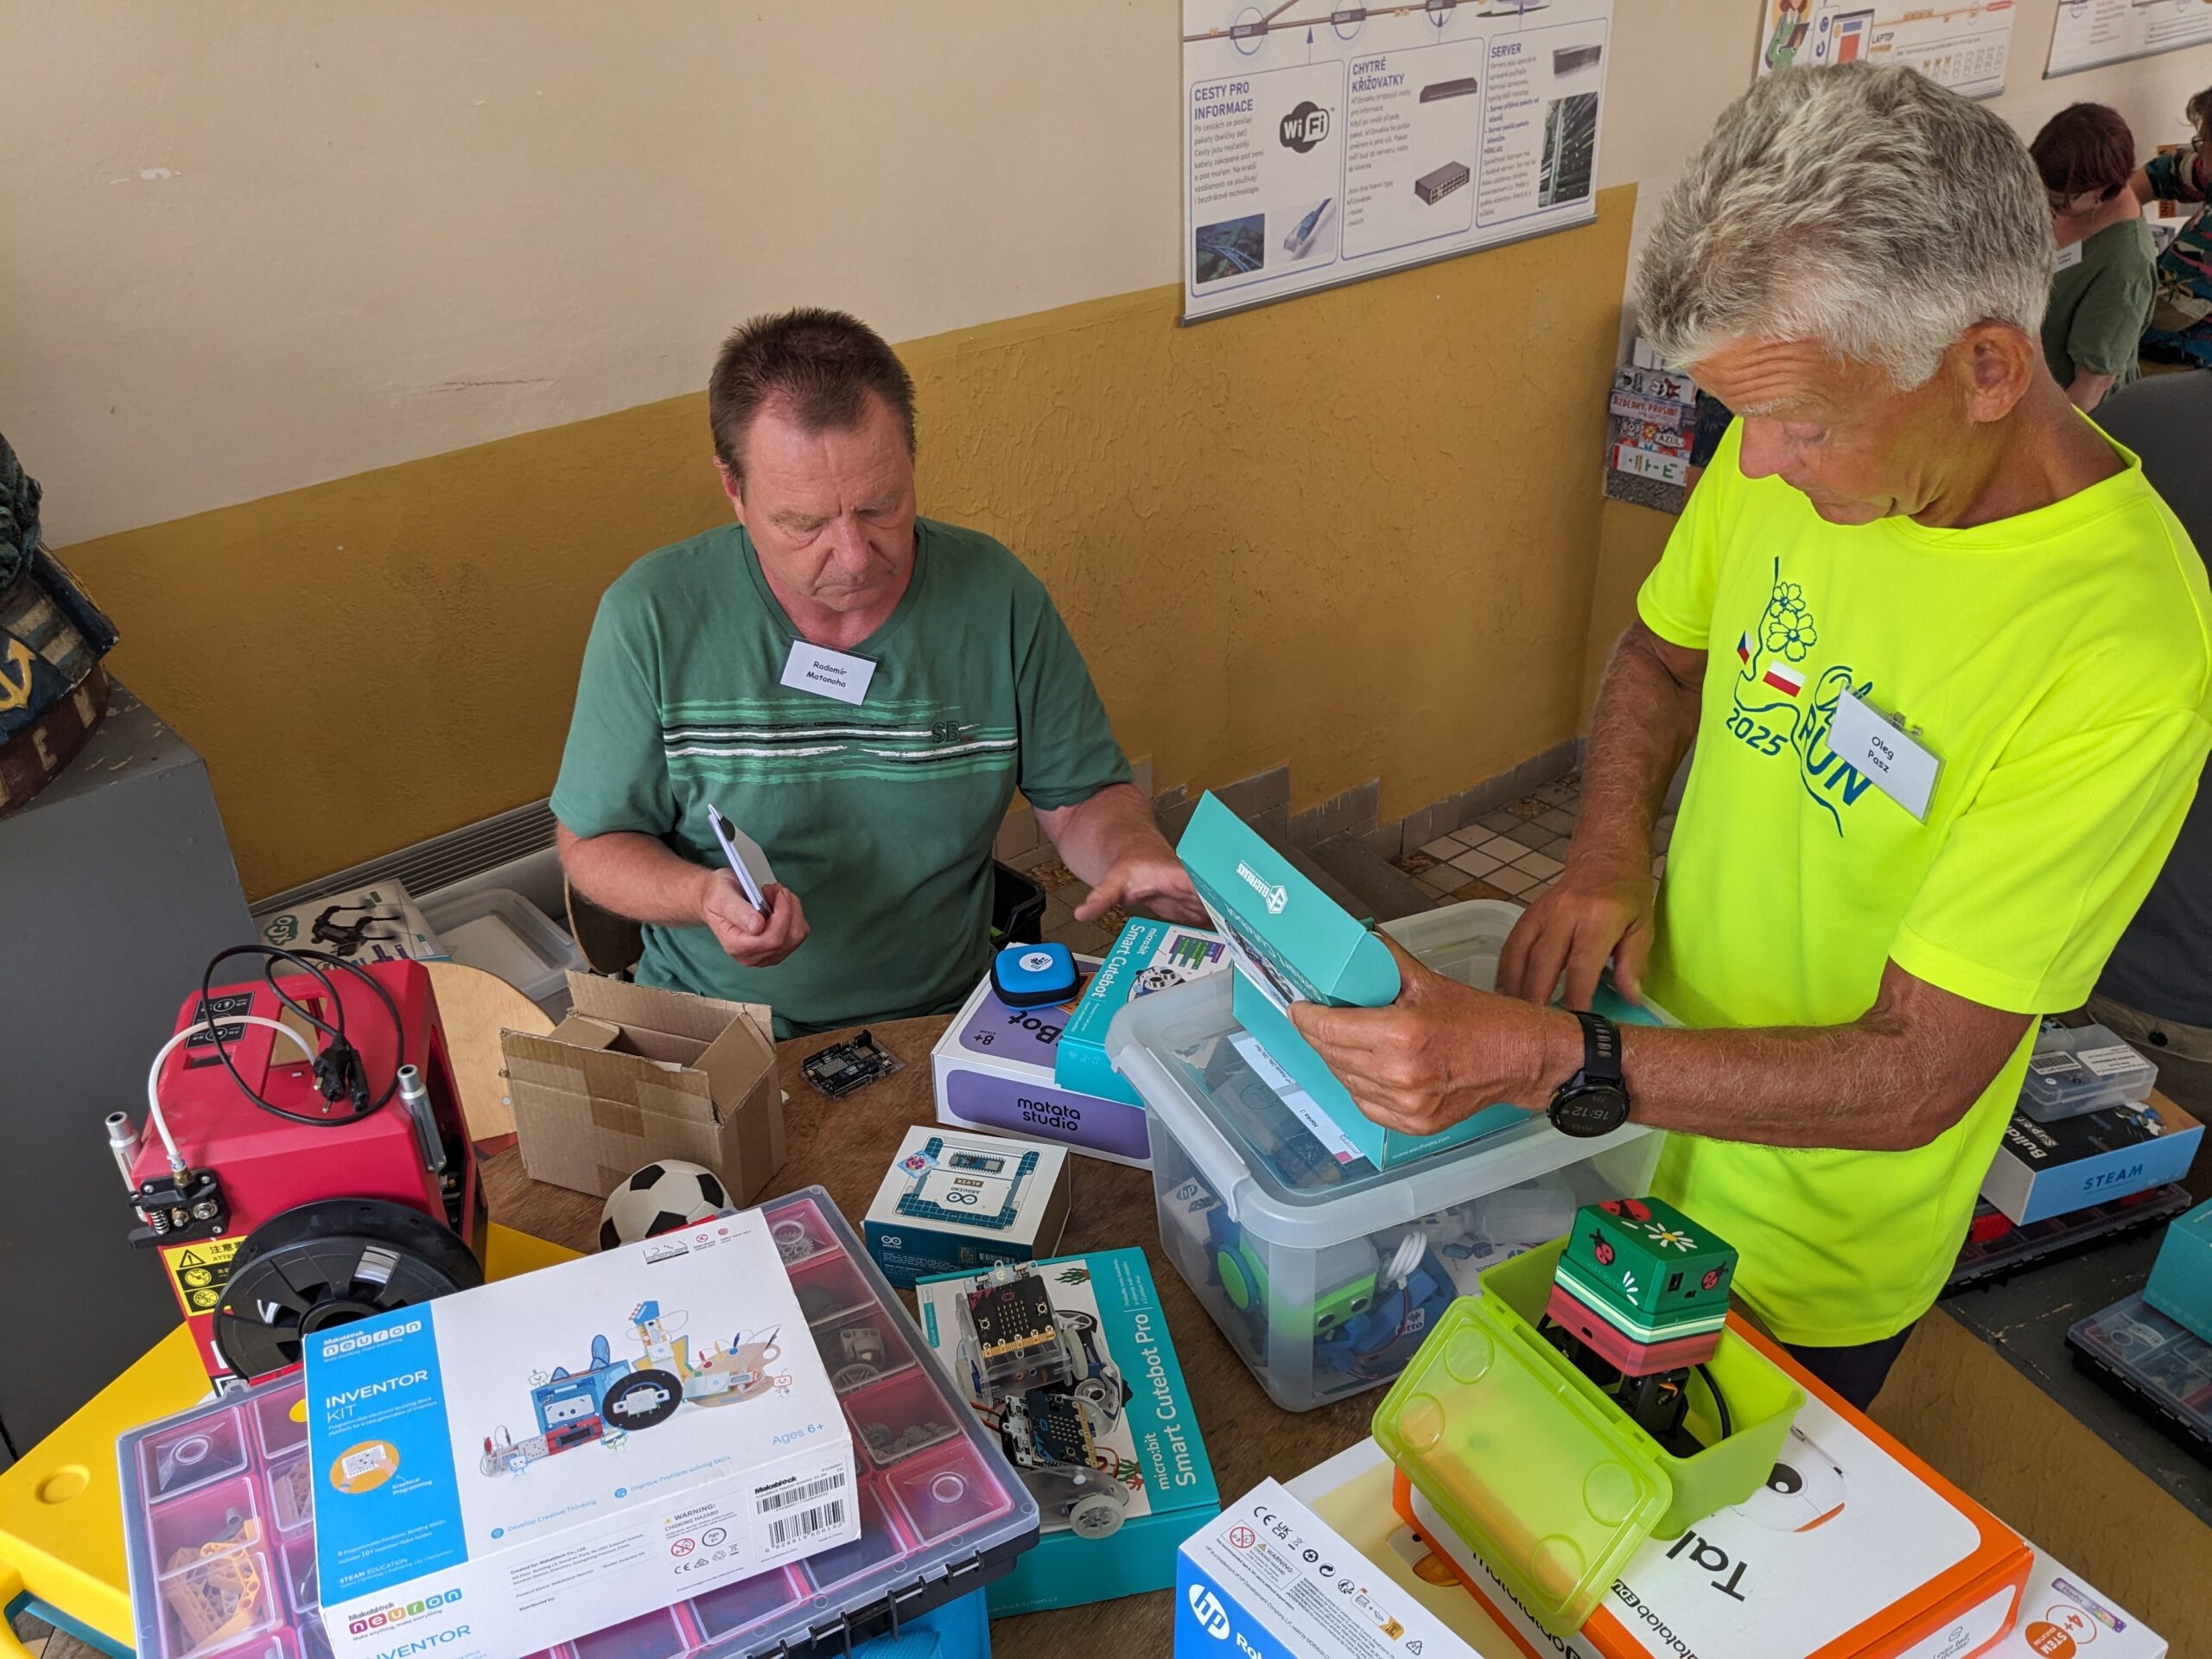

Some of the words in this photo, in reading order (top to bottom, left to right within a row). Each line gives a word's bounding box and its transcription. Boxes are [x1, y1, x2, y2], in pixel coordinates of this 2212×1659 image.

[1872, 33, 1894, 43] LAPTOP
[1491, 43, 1522, 58] SERVER
[1353, 56, 1386, 75] CHYTRÉ
[1195, 86, 1227, 101] CESTY
[1230, 81, 1249, 96] PRO
[1352, 73, 1405, 93] KŘIŽOVATKY
[1195, 99, 1253, 120] INFORMACE
[1658, 433, 1682, 447] AZUL
[805, 671, 847, 688] Matonoha
[813, 660, 847, 676] Radomír
[931, 721, 961, 743] SB
[1726, 707, 1789, 756] 2025
[1871, 735, 1895, 760] Oleg
[1867, 749, 1891, 774] Pasz
[1236, 862, 1269, 898] ELECFREAKS
[1120, 925, 1145, 955] Smart
[1136, 927, 1157, 955] micro:bit
[1091, 956, 1127, 998] Cutebot
[973, 1035, 995, 1046] 8+
[1017, 1097, 1081, 1121] matata
[1022, 1110, 1078, 1131] studio
[2083, 1164, 2143, 1191] STEAM
[322, 1320, 423, 1357] neuron
[323, 1330, 364, 1347] Makeblock
[1135, 1313, 1156, 1343] Pro
[323, 1369, 430, 1409] INVENTOR
[1141, 1346, 1177, 1421] Cutebot
[325, 1403, 359, 1423] KIT
[770, 1427, 805, 1447] Ages
[805, 1420, 826, 1434] 6+
[1150, 1431, 1171, 1490] micro:bit
[1163, 1423, 1197, 1487] Smart
[391, 1477, 421, 1490] Graphical
[629, 1477, 659, 1492] Improve
[658, 1460, 714, 1483] Problem-solving
[712, 1453, 731, 1465] Skills
[391, 1478, 433, 1495] Programming
[753, 1475, 798, 1494] Makeblock
[506, 1517, 537, 1533] Develop
[536, 1508, 567, 1523] Creative
[566, 1497, 598, 1513] Thinking
[664, 1518, 694, 1531] CHOKING
[693, 1510, 719, 1521] HAZARD
[673, 1502, 717, 1521] WARNING:
[1271, 1526, 1287, 1541] CA
[1277, 1522, 1293, 1535] UK
[360, 1548, 374, 1557] 10+
[509, 1566, 531, 1574] Created
[538, 1553, 566, 1564] Makeblock
[1220, 1542, 1243, 1563] recommended
[1252, 1545, 1271, 1562] CHOKING
[1269, 1560, 1286, 1576] HAZARD
[1265, 1548, 1295, 1575] WARNING:
[340, 1571, 365, 1583] STEAM
[365, 1556, 409, 1574] EDUCATION
[1666, 1530, 1748, 1602] Tal
[1204, 1543, 1212, 1553] HP
[1215, 1555, 1236, 1574] trademark
[1236, 1574, 1246, 1583] HP
[1242, 1580, 1269, 1605] Development
[1265, 1601, 1287, 1620] Company,
[1290, 1624, 1302, 1636] used
[1305, 1637, 1326, 1656] MORAVIA
[1613, 1581, 1637, 1605] EDU
[346, 1600, 396, 1621] Makeblock
[346, 1586, 465, 1636] neuron
[518, 1599, 547, 1611] Distributed
[1189, 1584, 1230, 1639] hp
[352, 1632, 369, 1642] Make
[368, 1624, 396, 1637] anything,
[395, 1618, 412, 1627] make
[411, 1608, 443, 1622] everything
[2064, 1613, 2084, 1631] 4+
[2032, 1626, 2056, 1646] EDUCATION
[2039, 1631, 2069, 1655] STEM
